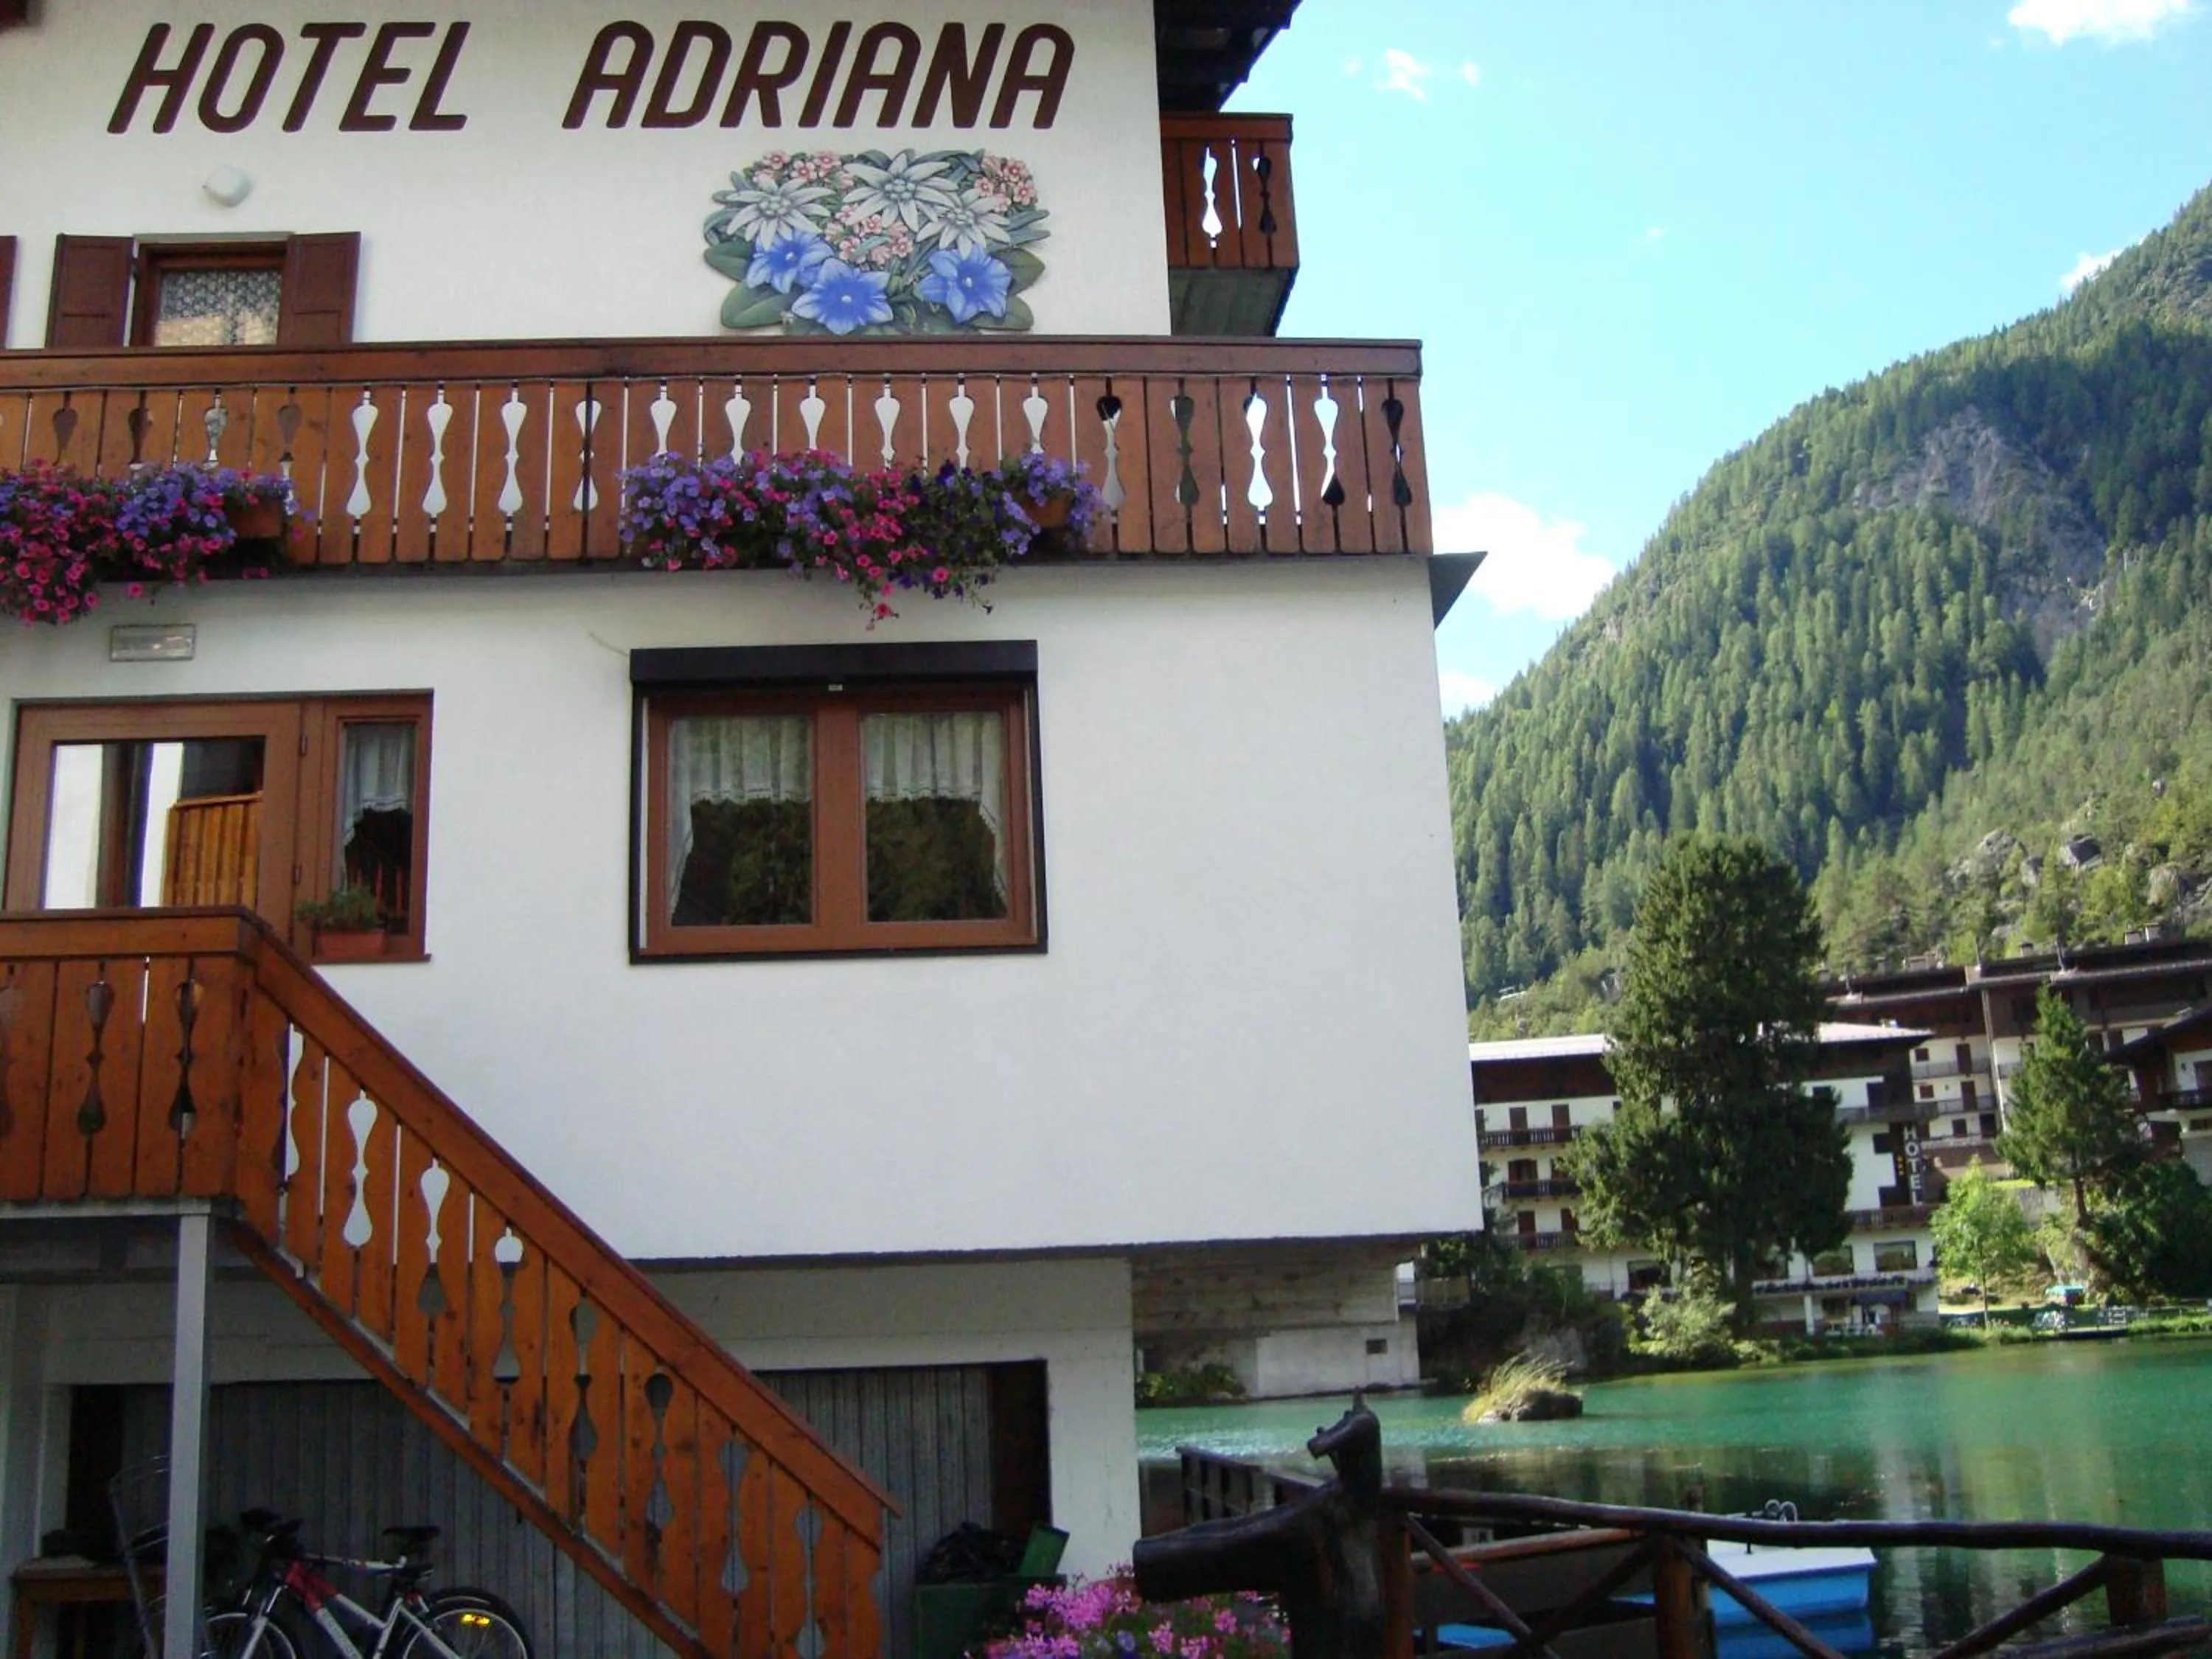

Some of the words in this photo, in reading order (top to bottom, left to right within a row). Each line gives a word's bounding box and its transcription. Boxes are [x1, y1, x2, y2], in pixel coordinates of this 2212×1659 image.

[107, 21, 471, 134] HOTEL
[561, 20, 1076, 129] ADRIANA
[1904, 1125, 1924, 1207] HOTEL
